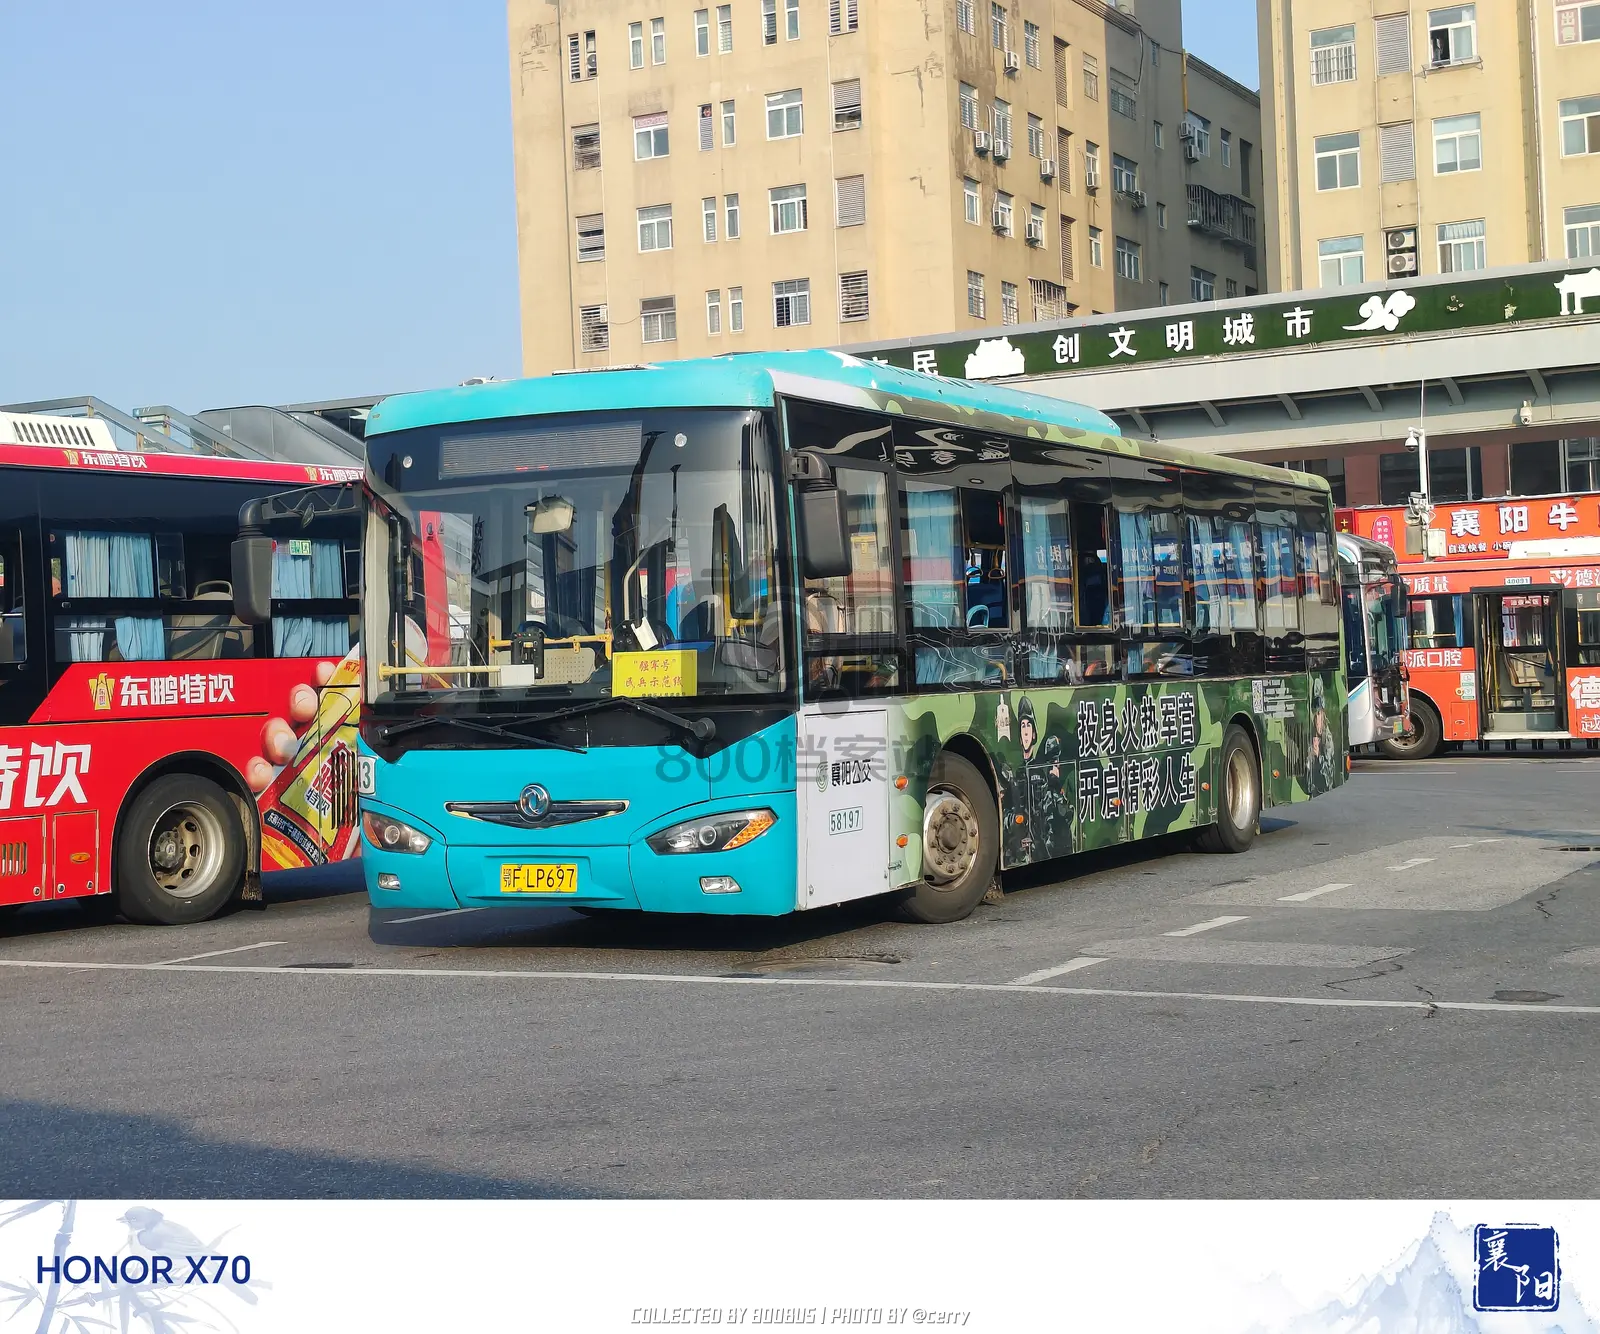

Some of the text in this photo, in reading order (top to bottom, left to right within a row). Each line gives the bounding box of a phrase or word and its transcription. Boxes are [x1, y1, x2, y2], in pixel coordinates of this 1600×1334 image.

[1052, 306, 1314, 365] 创文明城市
[82, 451, 147, 468] 东鹏特饮
[320, 467, 364, 481] 东鹏特
[1575, 569, 1600, 586] 德
[1404, 650, 1462, 668] 派口腔
[120, 673, 235, 706] 东鹏特饮
[1078, 692, 1195, 757] 投身火热军营
[831, 759, 871, 786] 襄阳公交
[1079, 752, 1196, 823] 开启精彩人生
[831, 810, 860, 831] 58197
